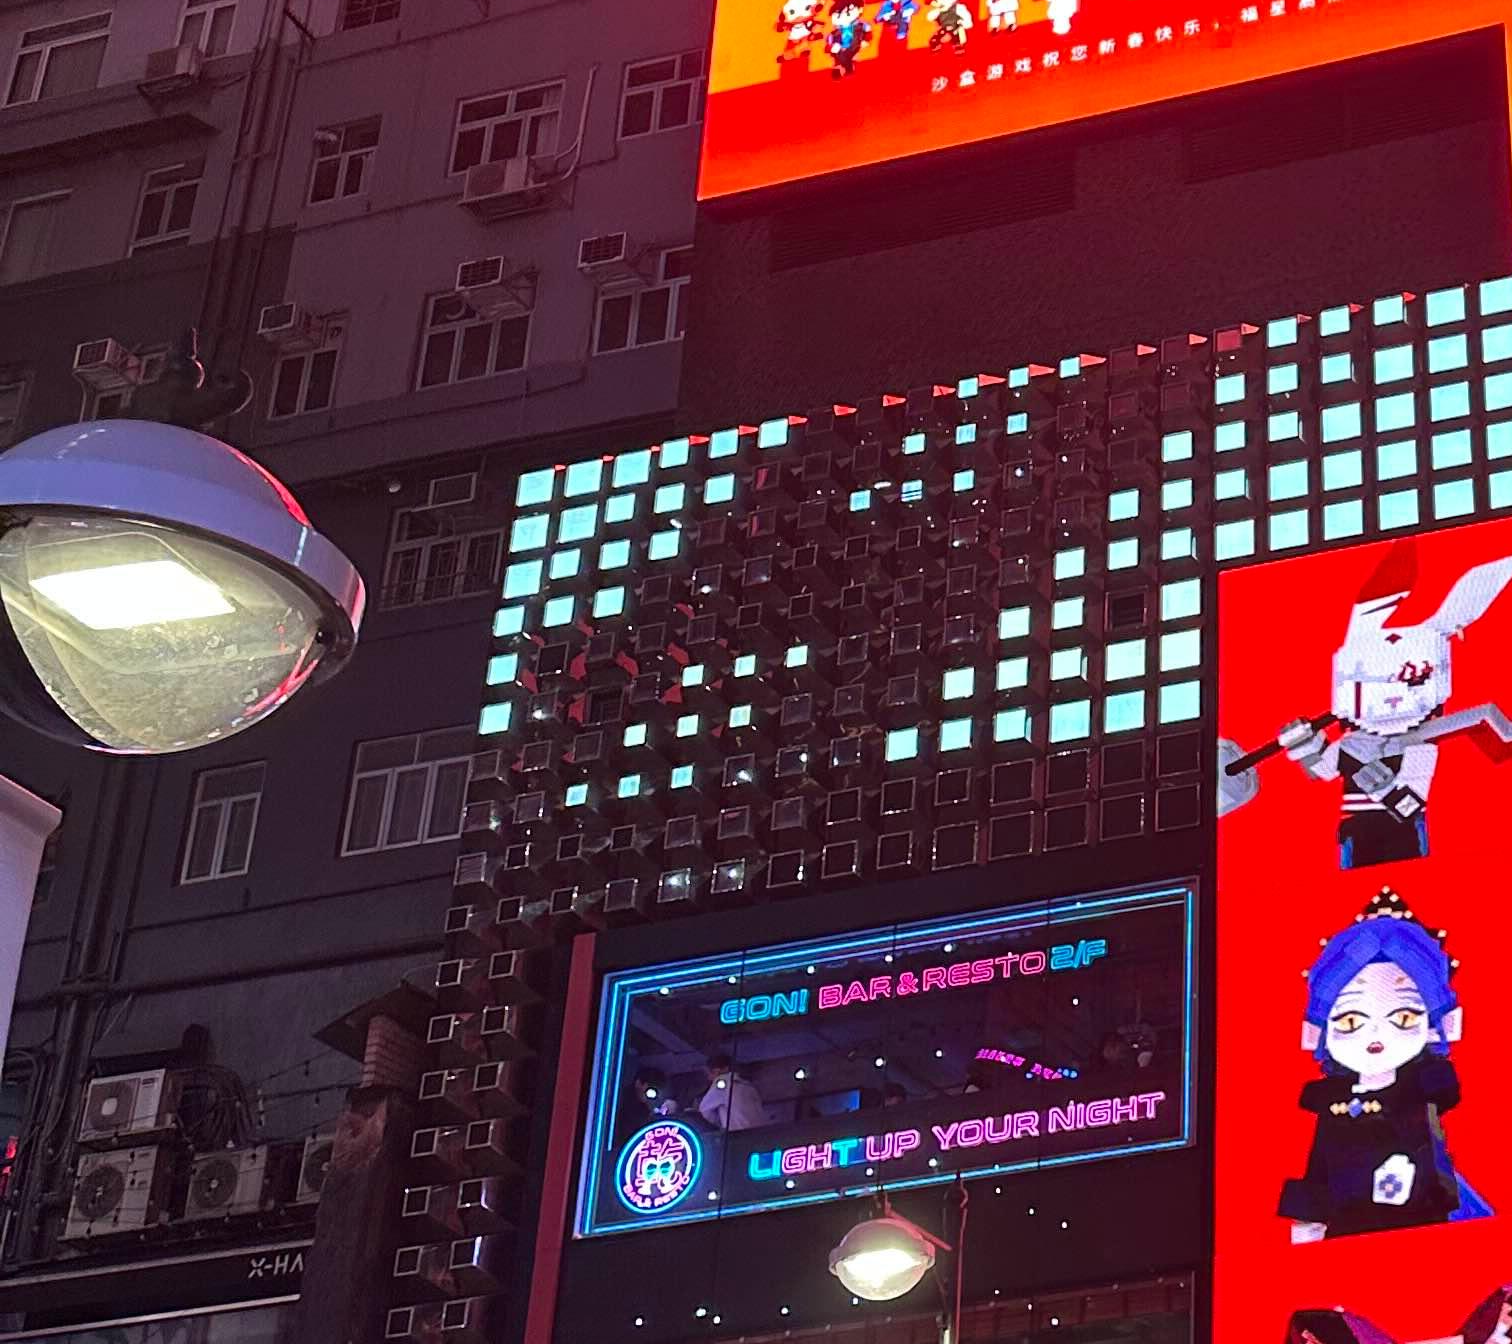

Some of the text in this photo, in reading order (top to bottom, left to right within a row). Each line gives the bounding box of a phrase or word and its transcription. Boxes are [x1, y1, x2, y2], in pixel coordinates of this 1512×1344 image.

[720, 989, 809, 1024] GON!
[818, 974, 893, 1009] BAR
[922, 951, 1046, 991] RESTO
[1049, 939, 1108, 972] 2/F
[749, 1092, 1166, 1180] LIGHT UP YOUR NIGHT
